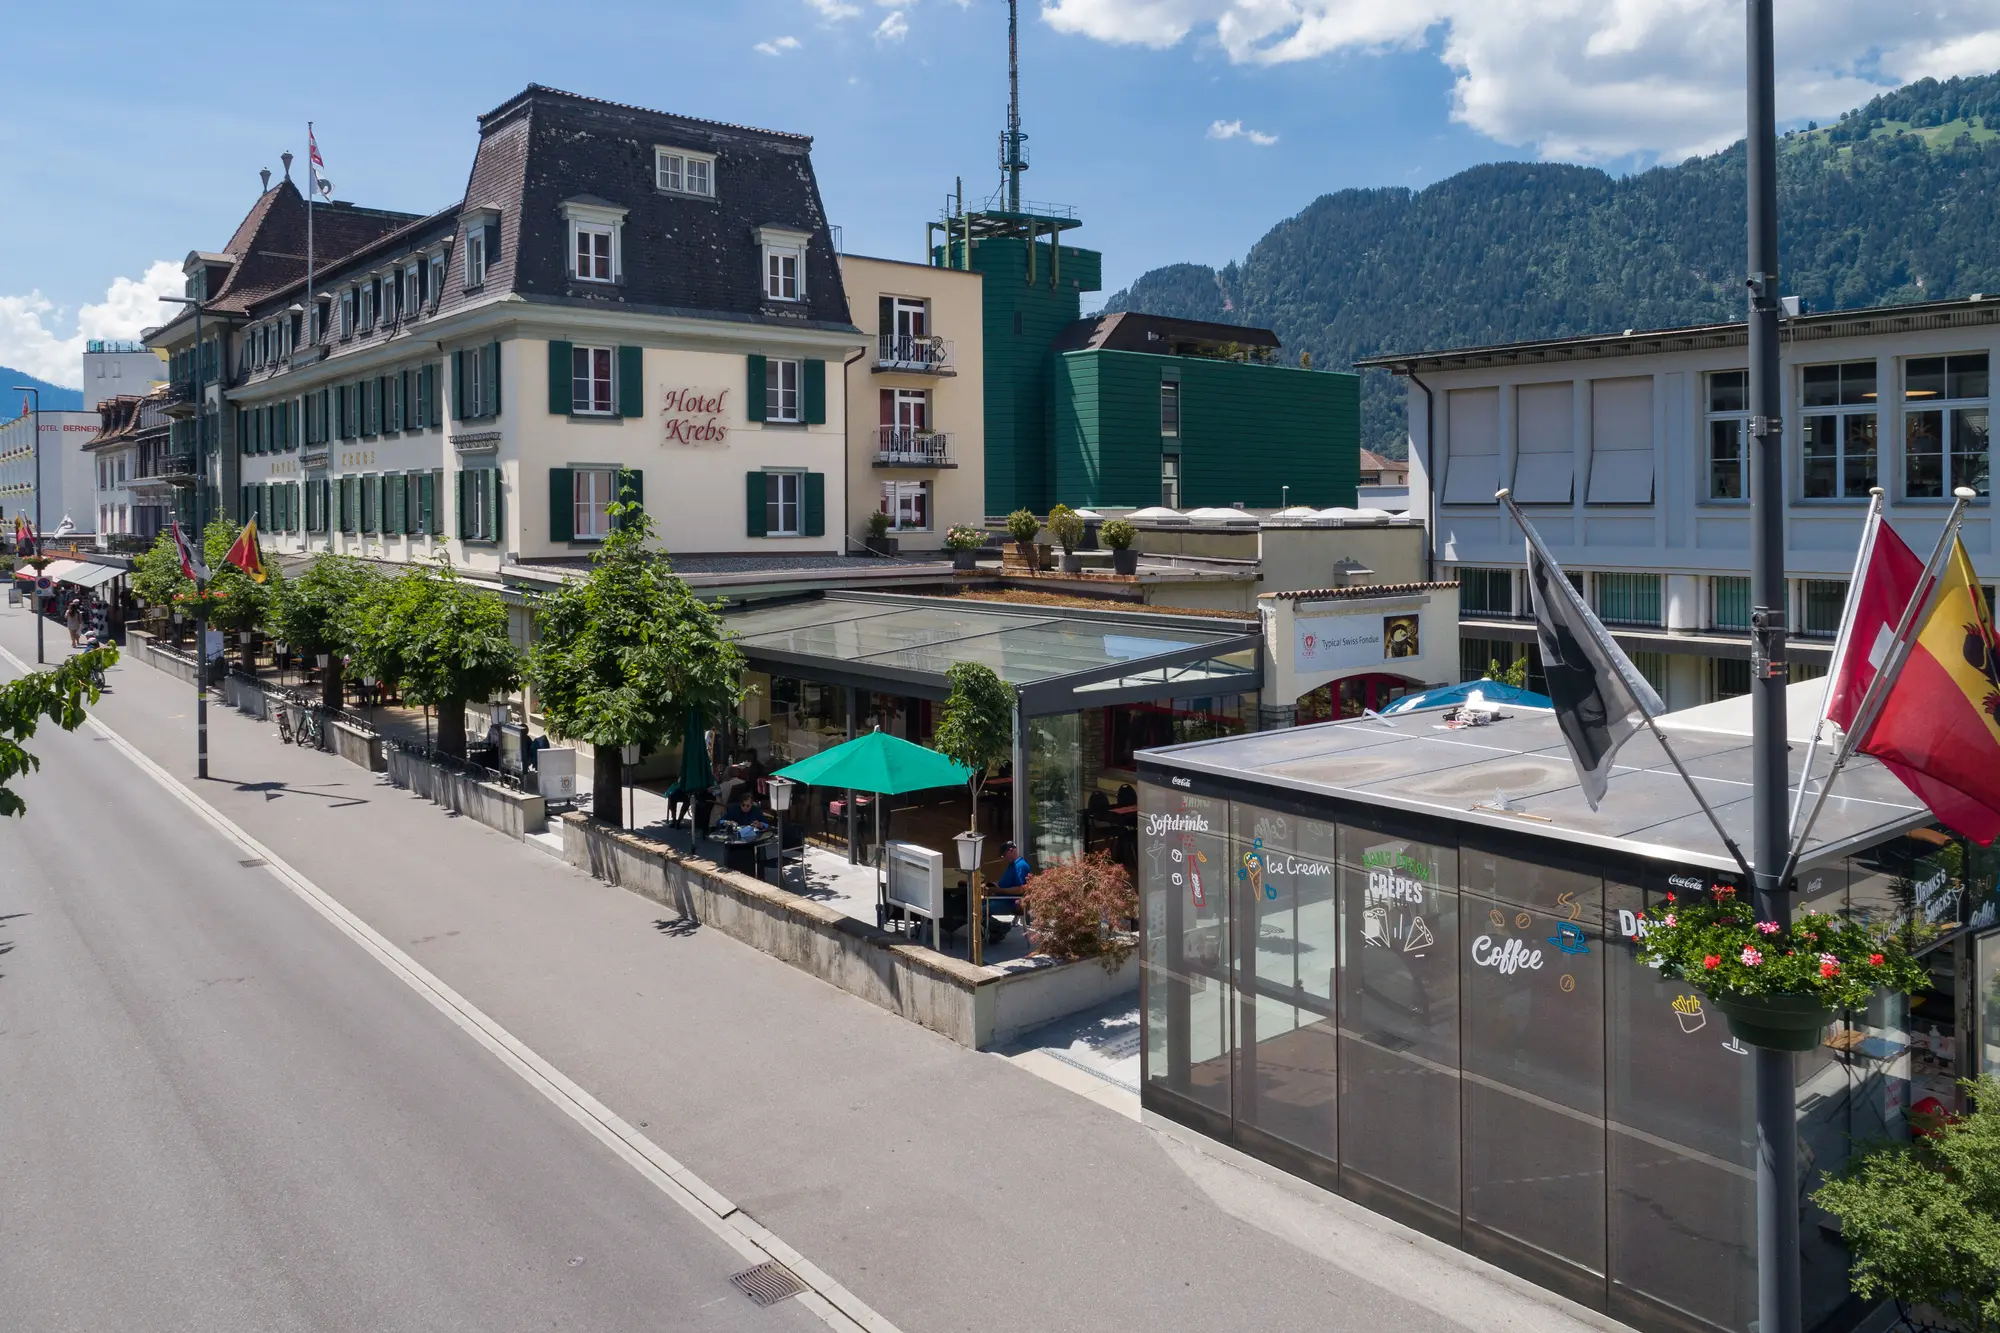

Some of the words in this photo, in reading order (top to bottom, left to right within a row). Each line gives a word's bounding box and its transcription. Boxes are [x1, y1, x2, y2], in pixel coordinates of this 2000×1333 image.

[664, 388, 728, 413] Hotel
[666, 417, 727, 445] Krebs
[1322, 638, 1342, 650] Typical
[1343, 637, 1359, 646] Swiss
[1359, 635, 1380, 645] Fondue
[1146, 813, 1209, 836] Softdrinks
[1266, 854, 1285, 874] Ice
[1286, 855, 1331, 876] Cream
[1471, 934, 1544, 975] Coffee
